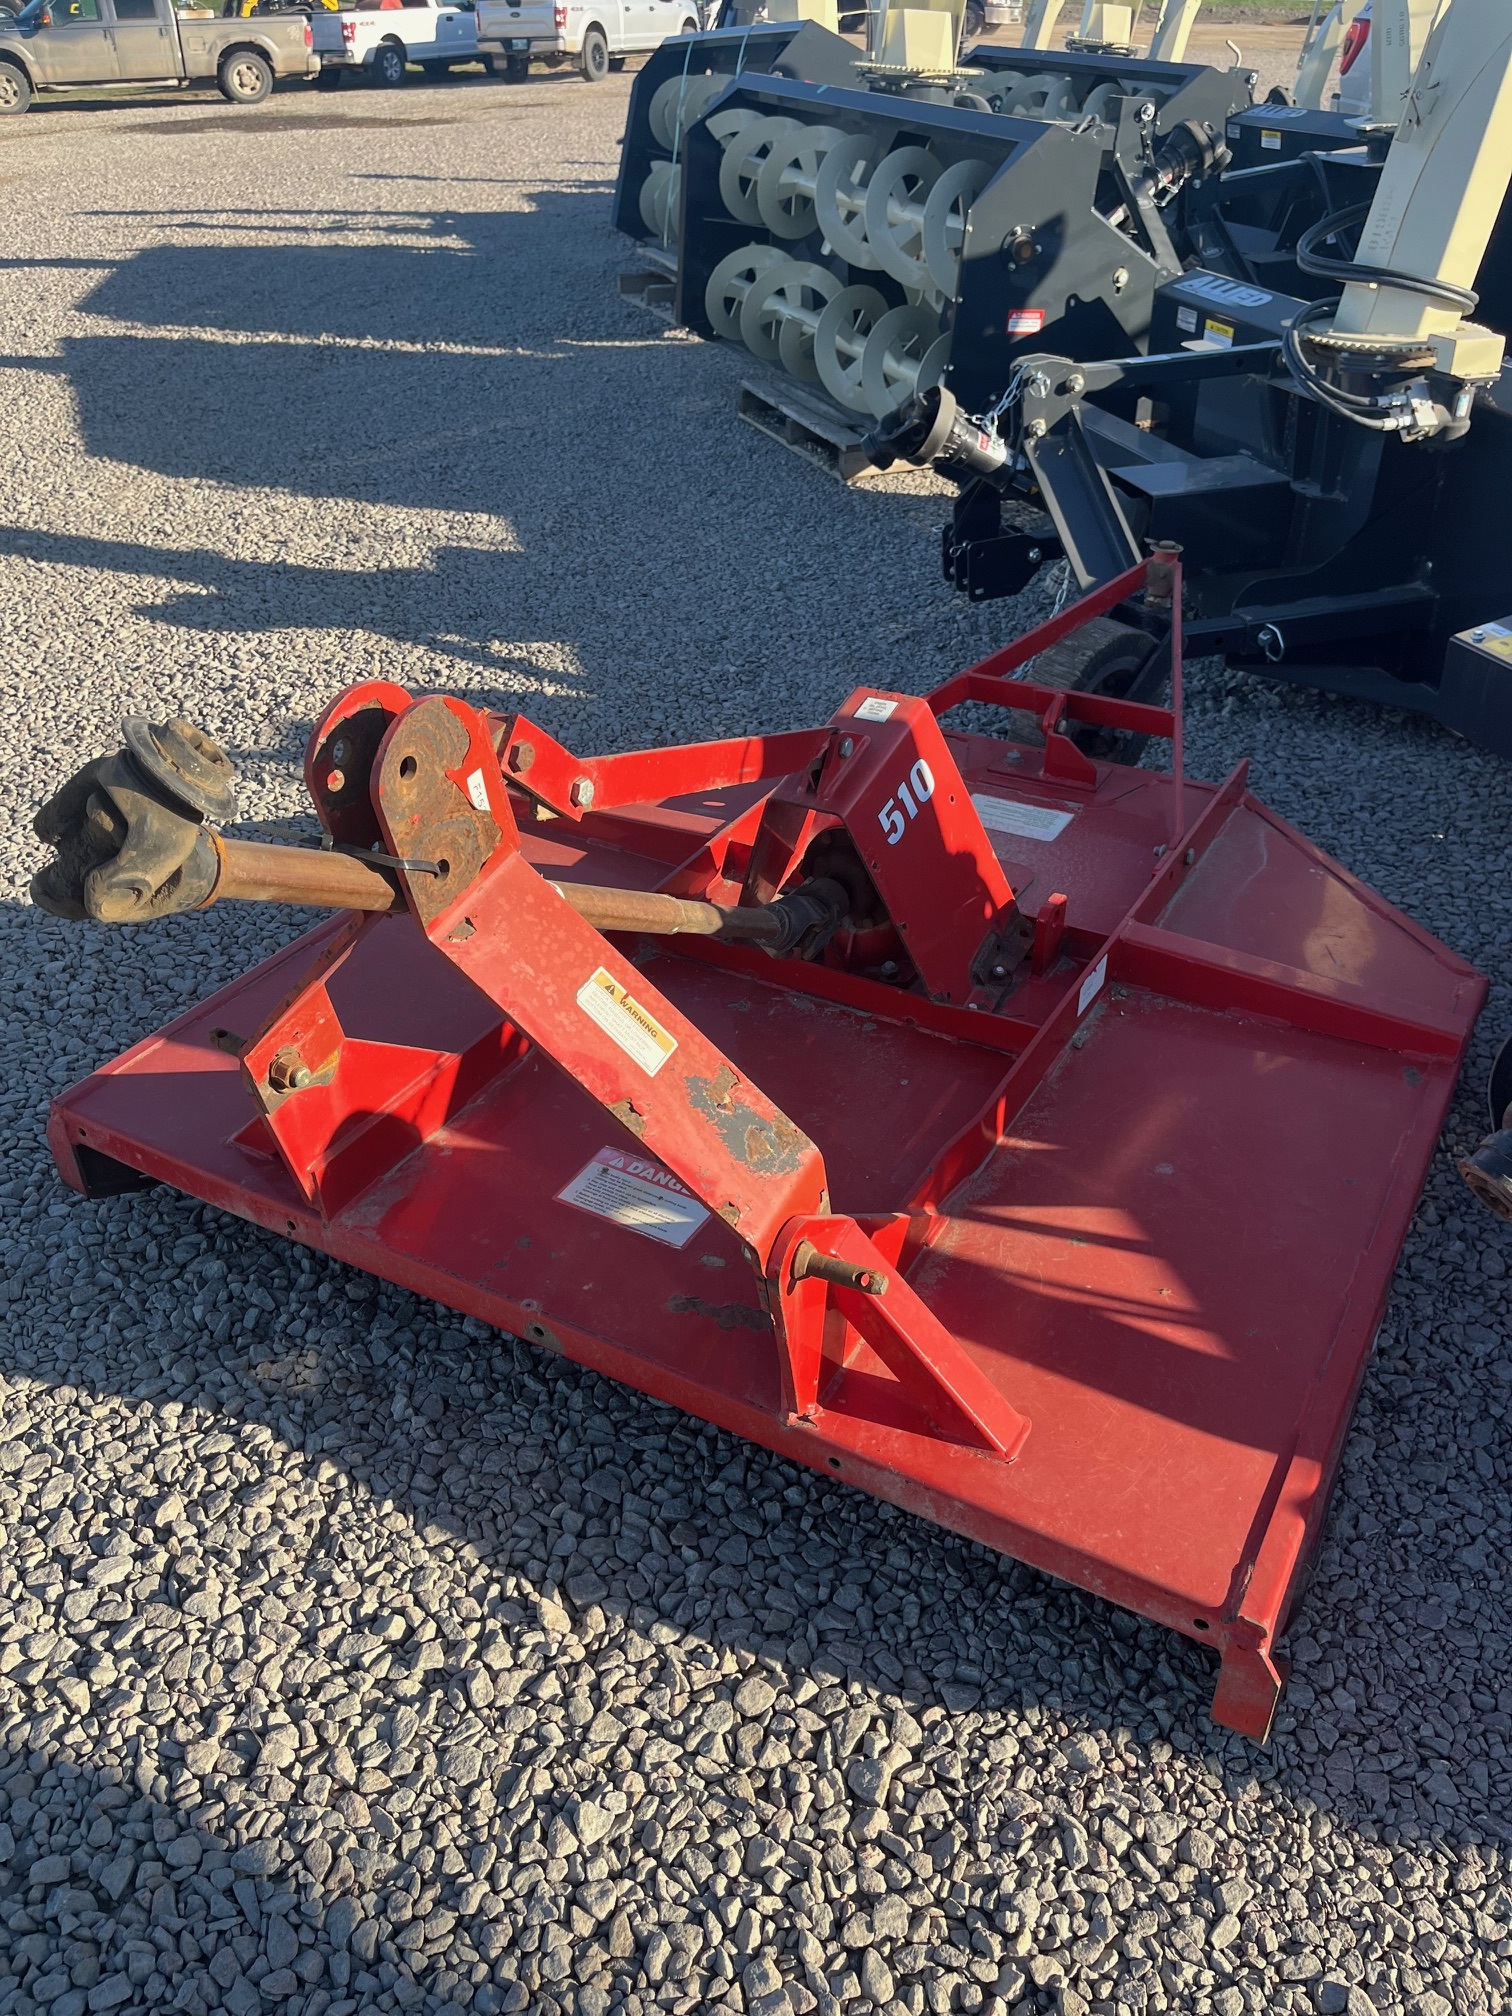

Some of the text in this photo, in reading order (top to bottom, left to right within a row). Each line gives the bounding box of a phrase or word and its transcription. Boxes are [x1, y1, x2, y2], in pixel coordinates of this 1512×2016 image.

[1240, 105, 1308, 119] ALLIED
[1173, 275, 1273, 307] ALLIED
[877, 758, 935, 845] 510
[619, 998, 658, 1039] WARNING
[626, 1161, 691, 1195] DANG
